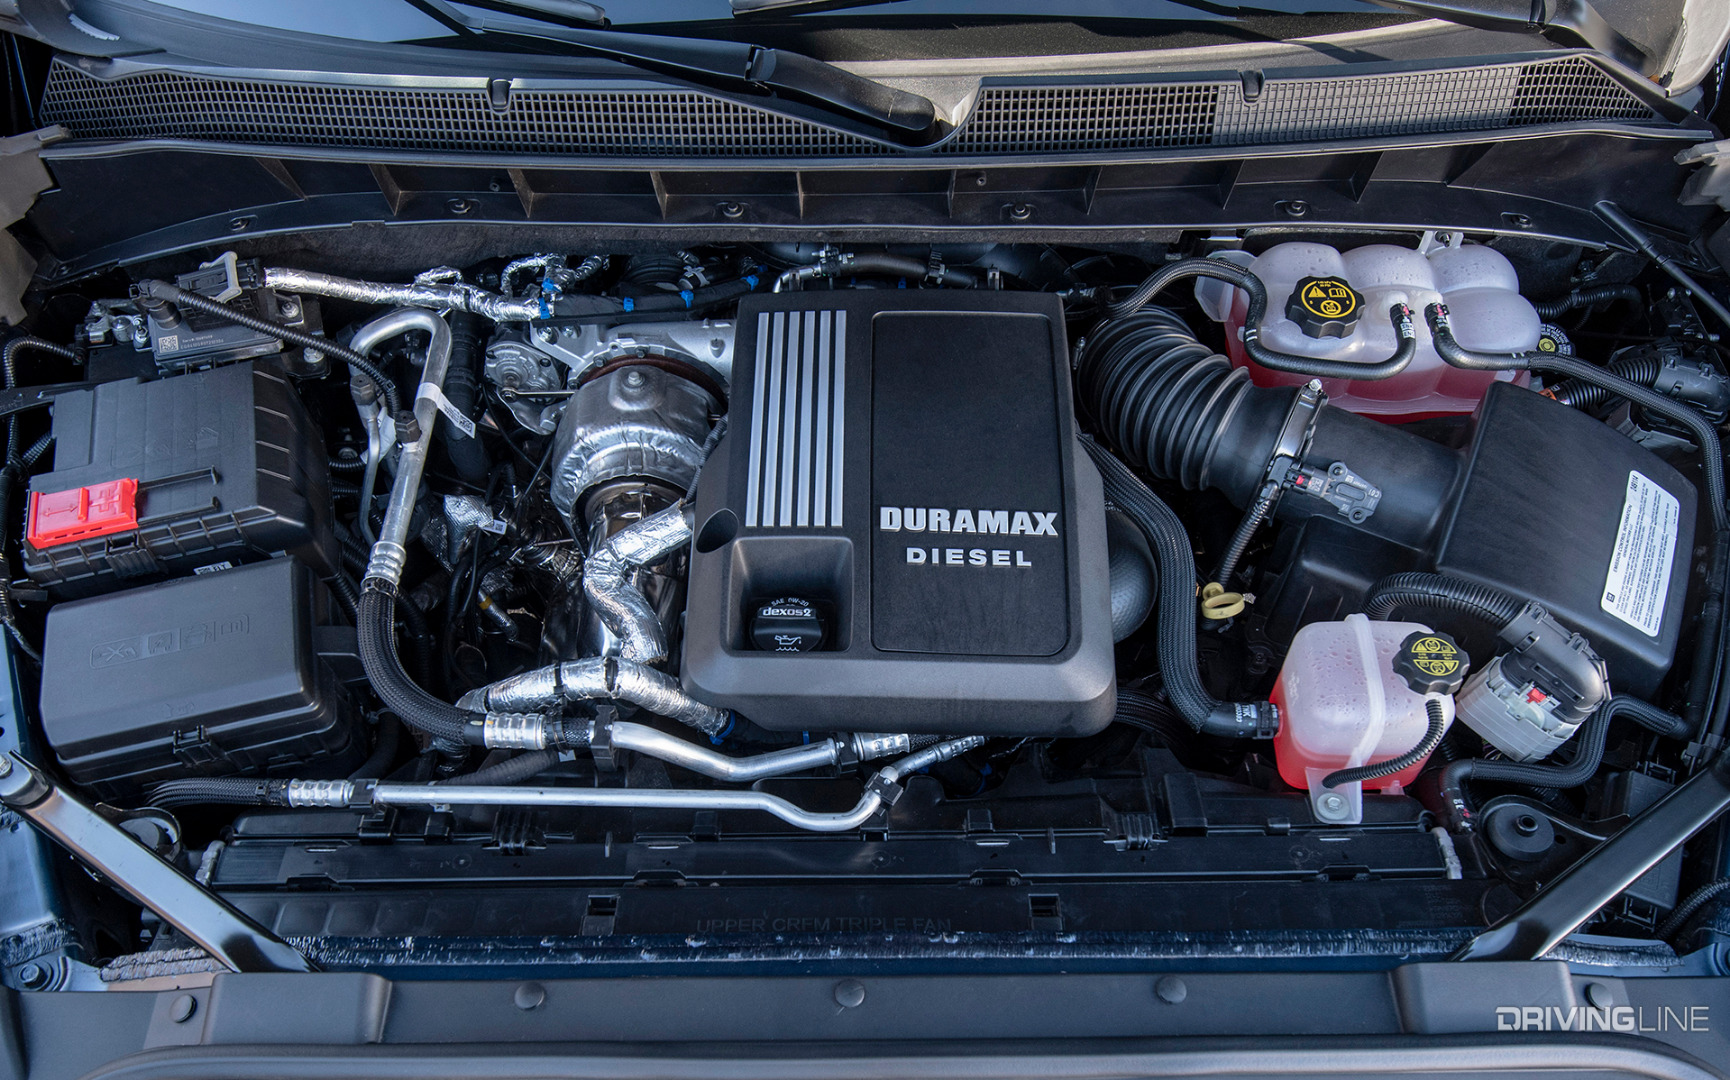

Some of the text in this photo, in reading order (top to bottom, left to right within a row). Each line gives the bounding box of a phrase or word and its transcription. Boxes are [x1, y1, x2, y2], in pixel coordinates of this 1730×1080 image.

[880, 506, 1058, 537] DURAMAX
[906, 547, 1032, 567] DIESEL
[771, 598, 785, 607] SAE
[762, 607, 812, 617] dexos2
[697, 918, 766, 934] UPPER
[835, 917, 906, 932] TRIPLE
[912, 917, 952, 932] FAN
